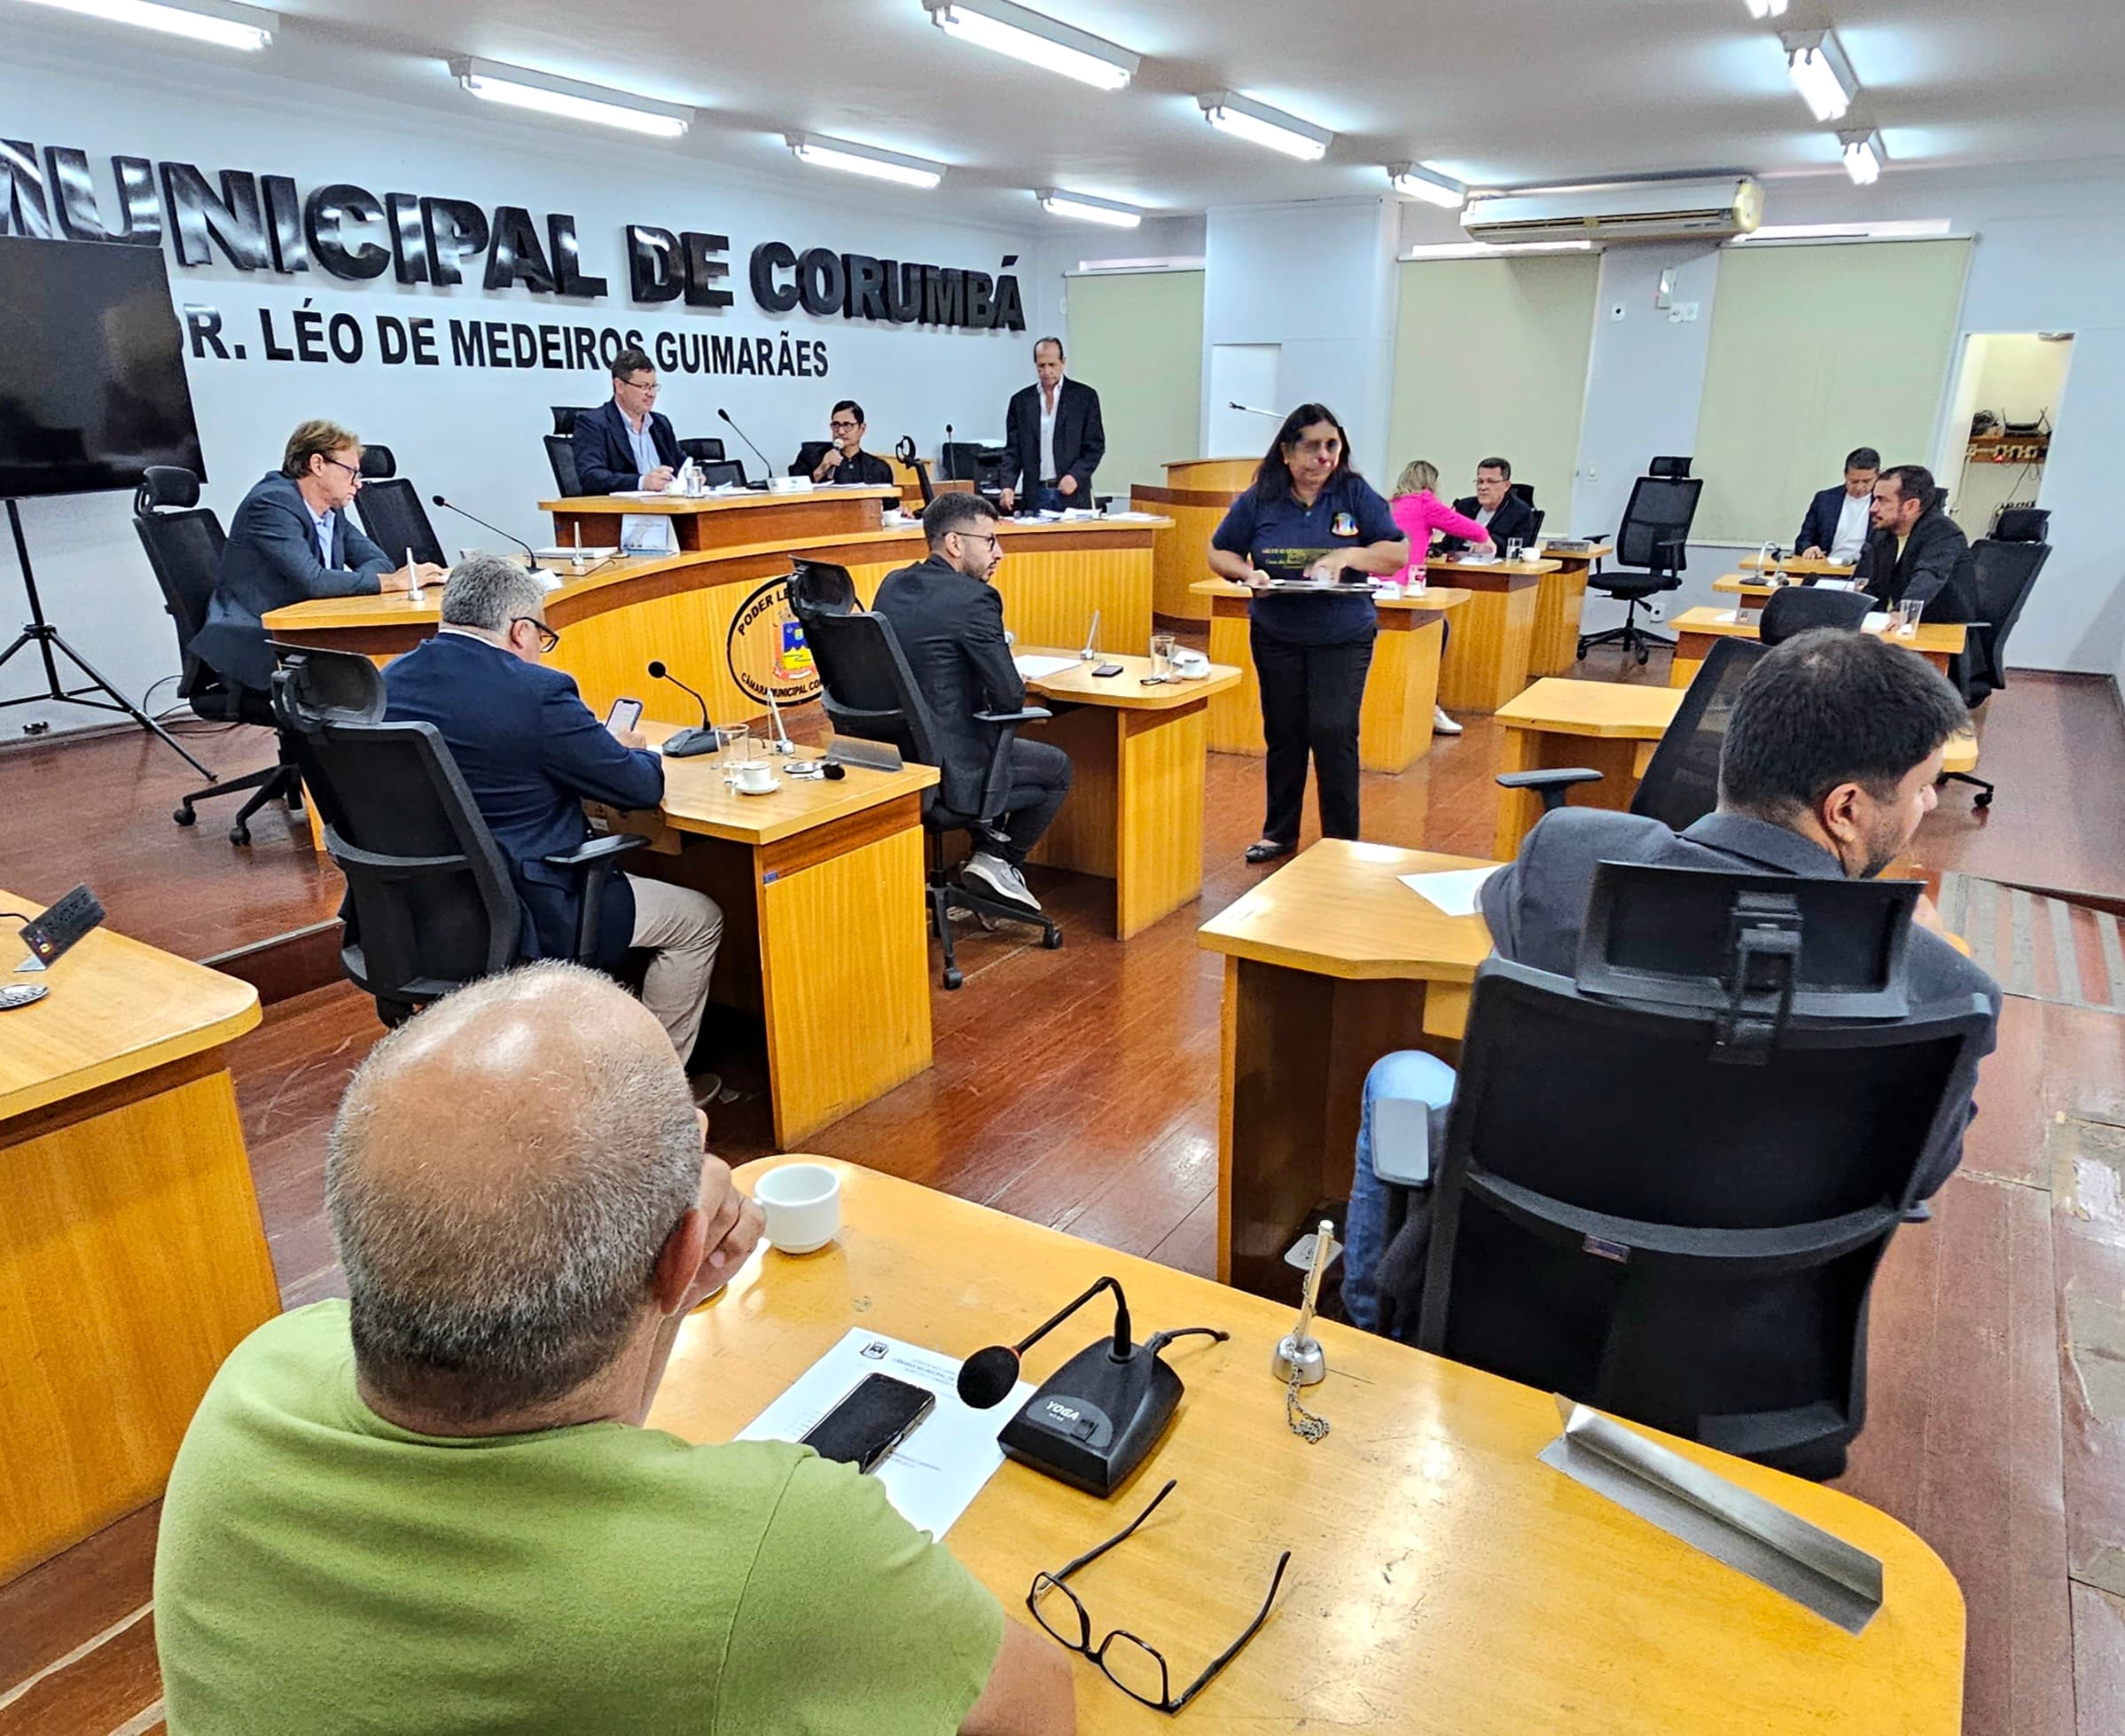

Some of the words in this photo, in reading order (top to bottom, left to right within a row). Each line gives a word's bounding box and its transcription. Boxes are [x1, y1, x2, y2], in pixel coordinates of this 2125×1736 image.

[626, 223, 733, 307] DE
[750, 241, 1026, 332] CORUMBÁ
[177, 303, 246, 360] R.
[258, 297, 363, 364] LÉO
[376, 316, 440, 365] DE
[655, 330, 828, 378] GUIMARÃES
[738, 595, 774, 636] PODER
[1046, 1401, 1080, 1420] YOGA
